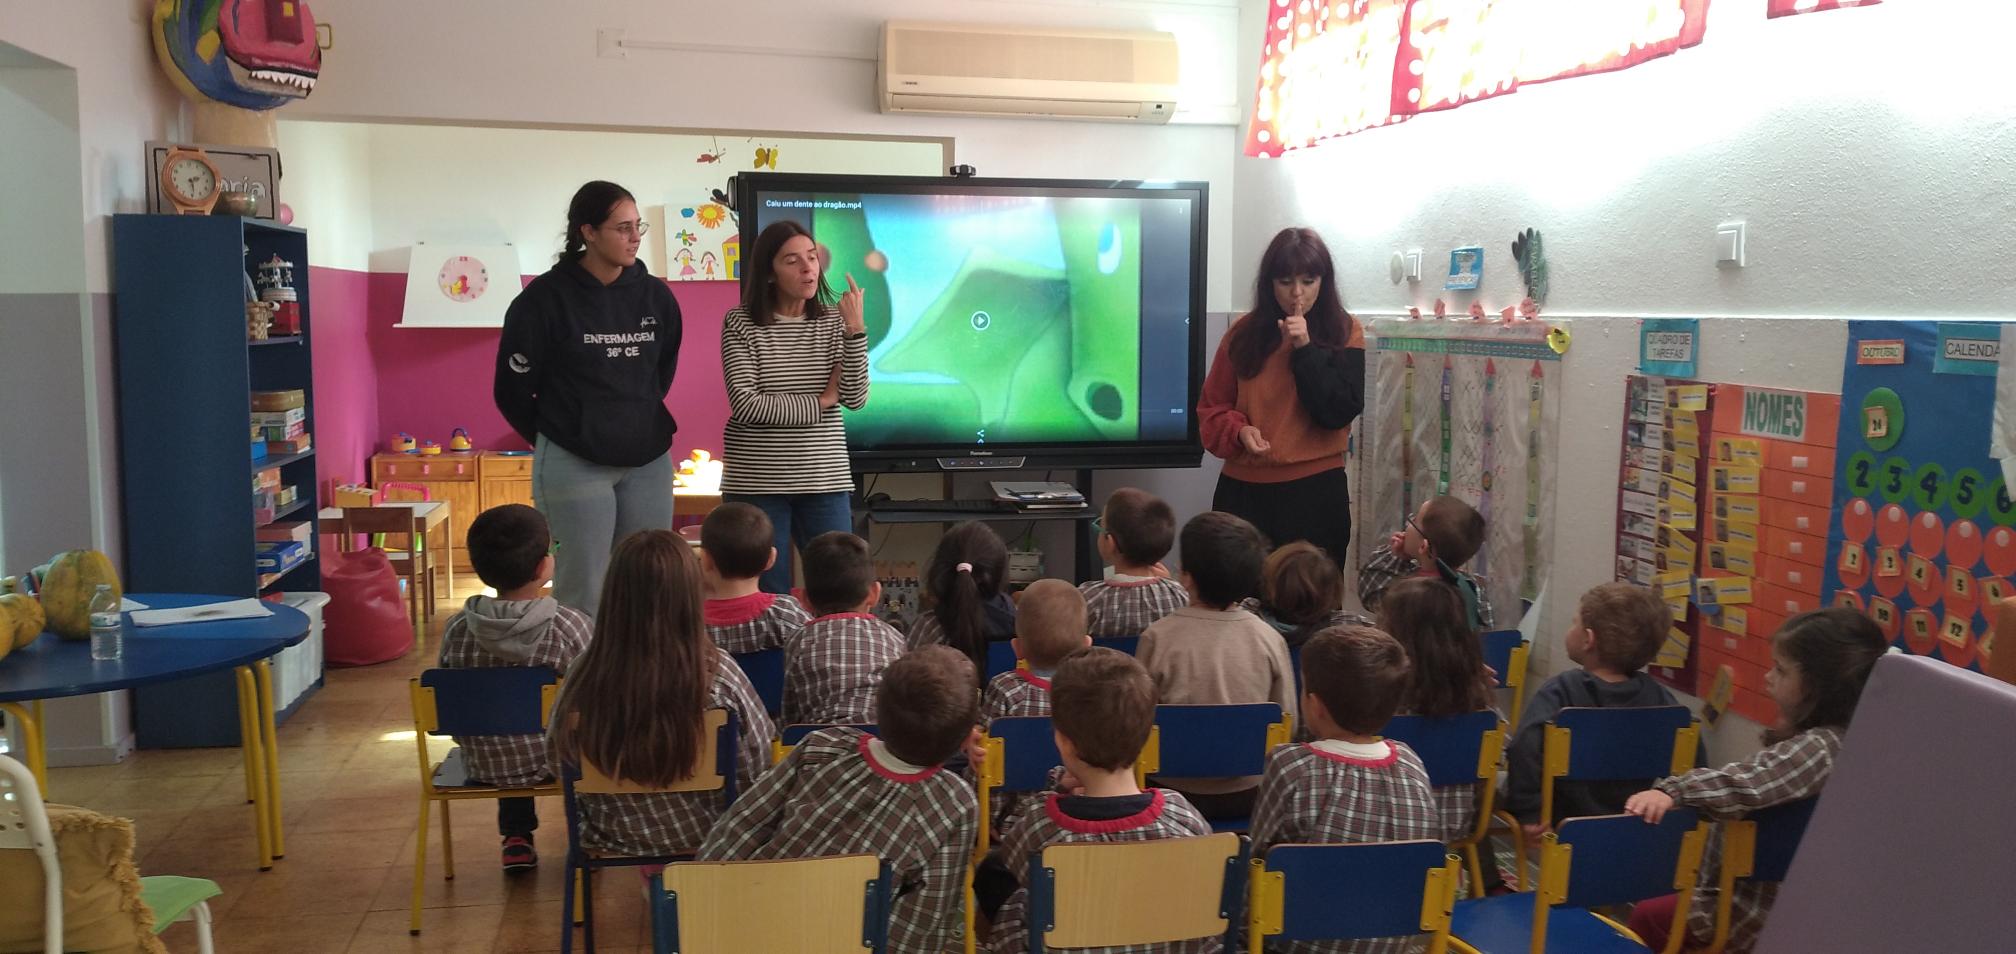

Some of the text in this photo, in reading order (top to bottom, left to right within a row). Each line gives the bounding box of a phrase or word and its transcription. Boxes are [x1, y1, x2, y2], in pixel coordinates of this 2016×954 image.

[766, 200, 781, 208] Caiu
[794, 200, 813, 209] dente
[823, 200, 862, 210] dragão.mp4
[583, 332, 655, 344] ENFERMAGEM
[1679, 335, 1691, 345] DE
[624, 346, 640, 357] CE
[1743, 391, 1804, 437] NOMES
[1855, 460, 1870, 488] 2
[1887, 465, 1902, 493] 3
[1920, 471, 1938, 503] 4
[1957, 475, 1976, 505] 5
[1914, 567, 1923, 579] 4
[1951, 623, 1964, 637] 12
